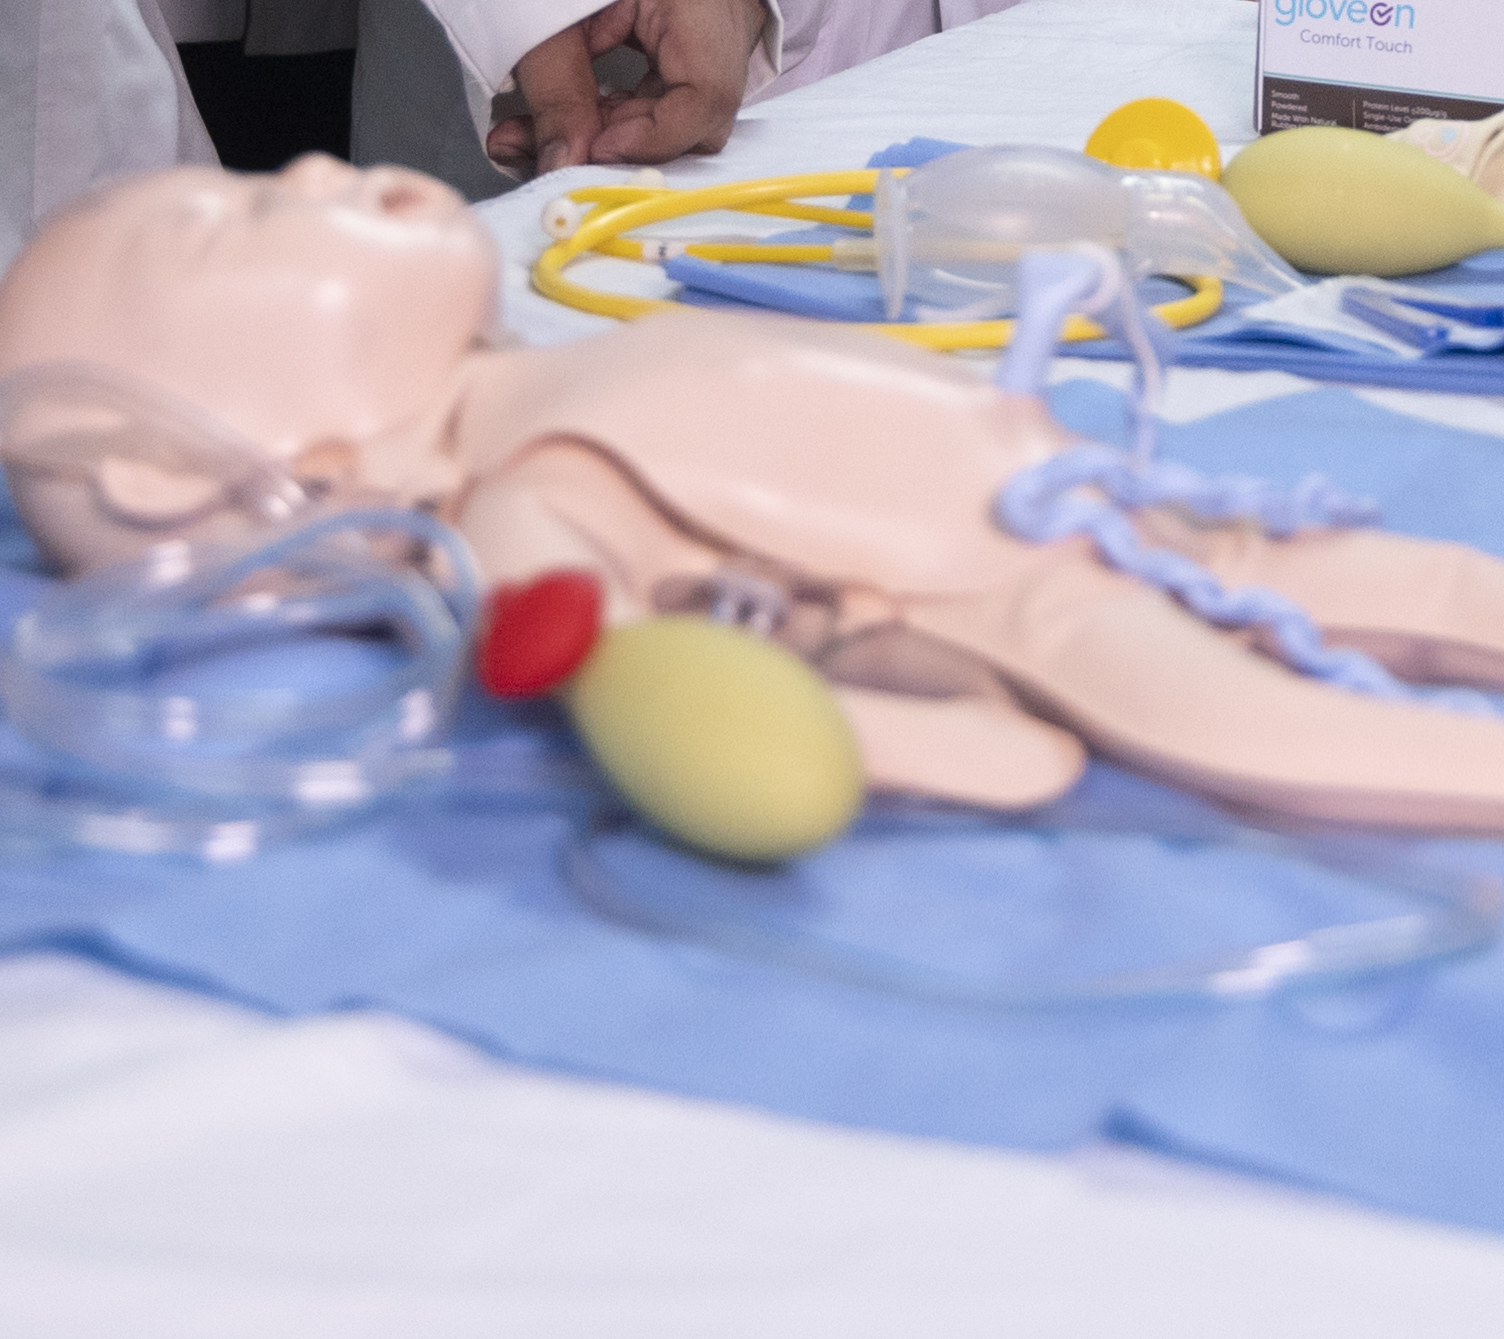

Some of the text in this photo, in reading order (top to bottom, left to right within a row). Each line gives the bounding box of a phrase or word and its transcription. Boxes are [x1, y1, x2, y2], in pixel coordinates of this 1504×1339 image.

[1300, 28, 1413, 54] Comfort Touch
[1271, 101, 1308, 113] Powdered
